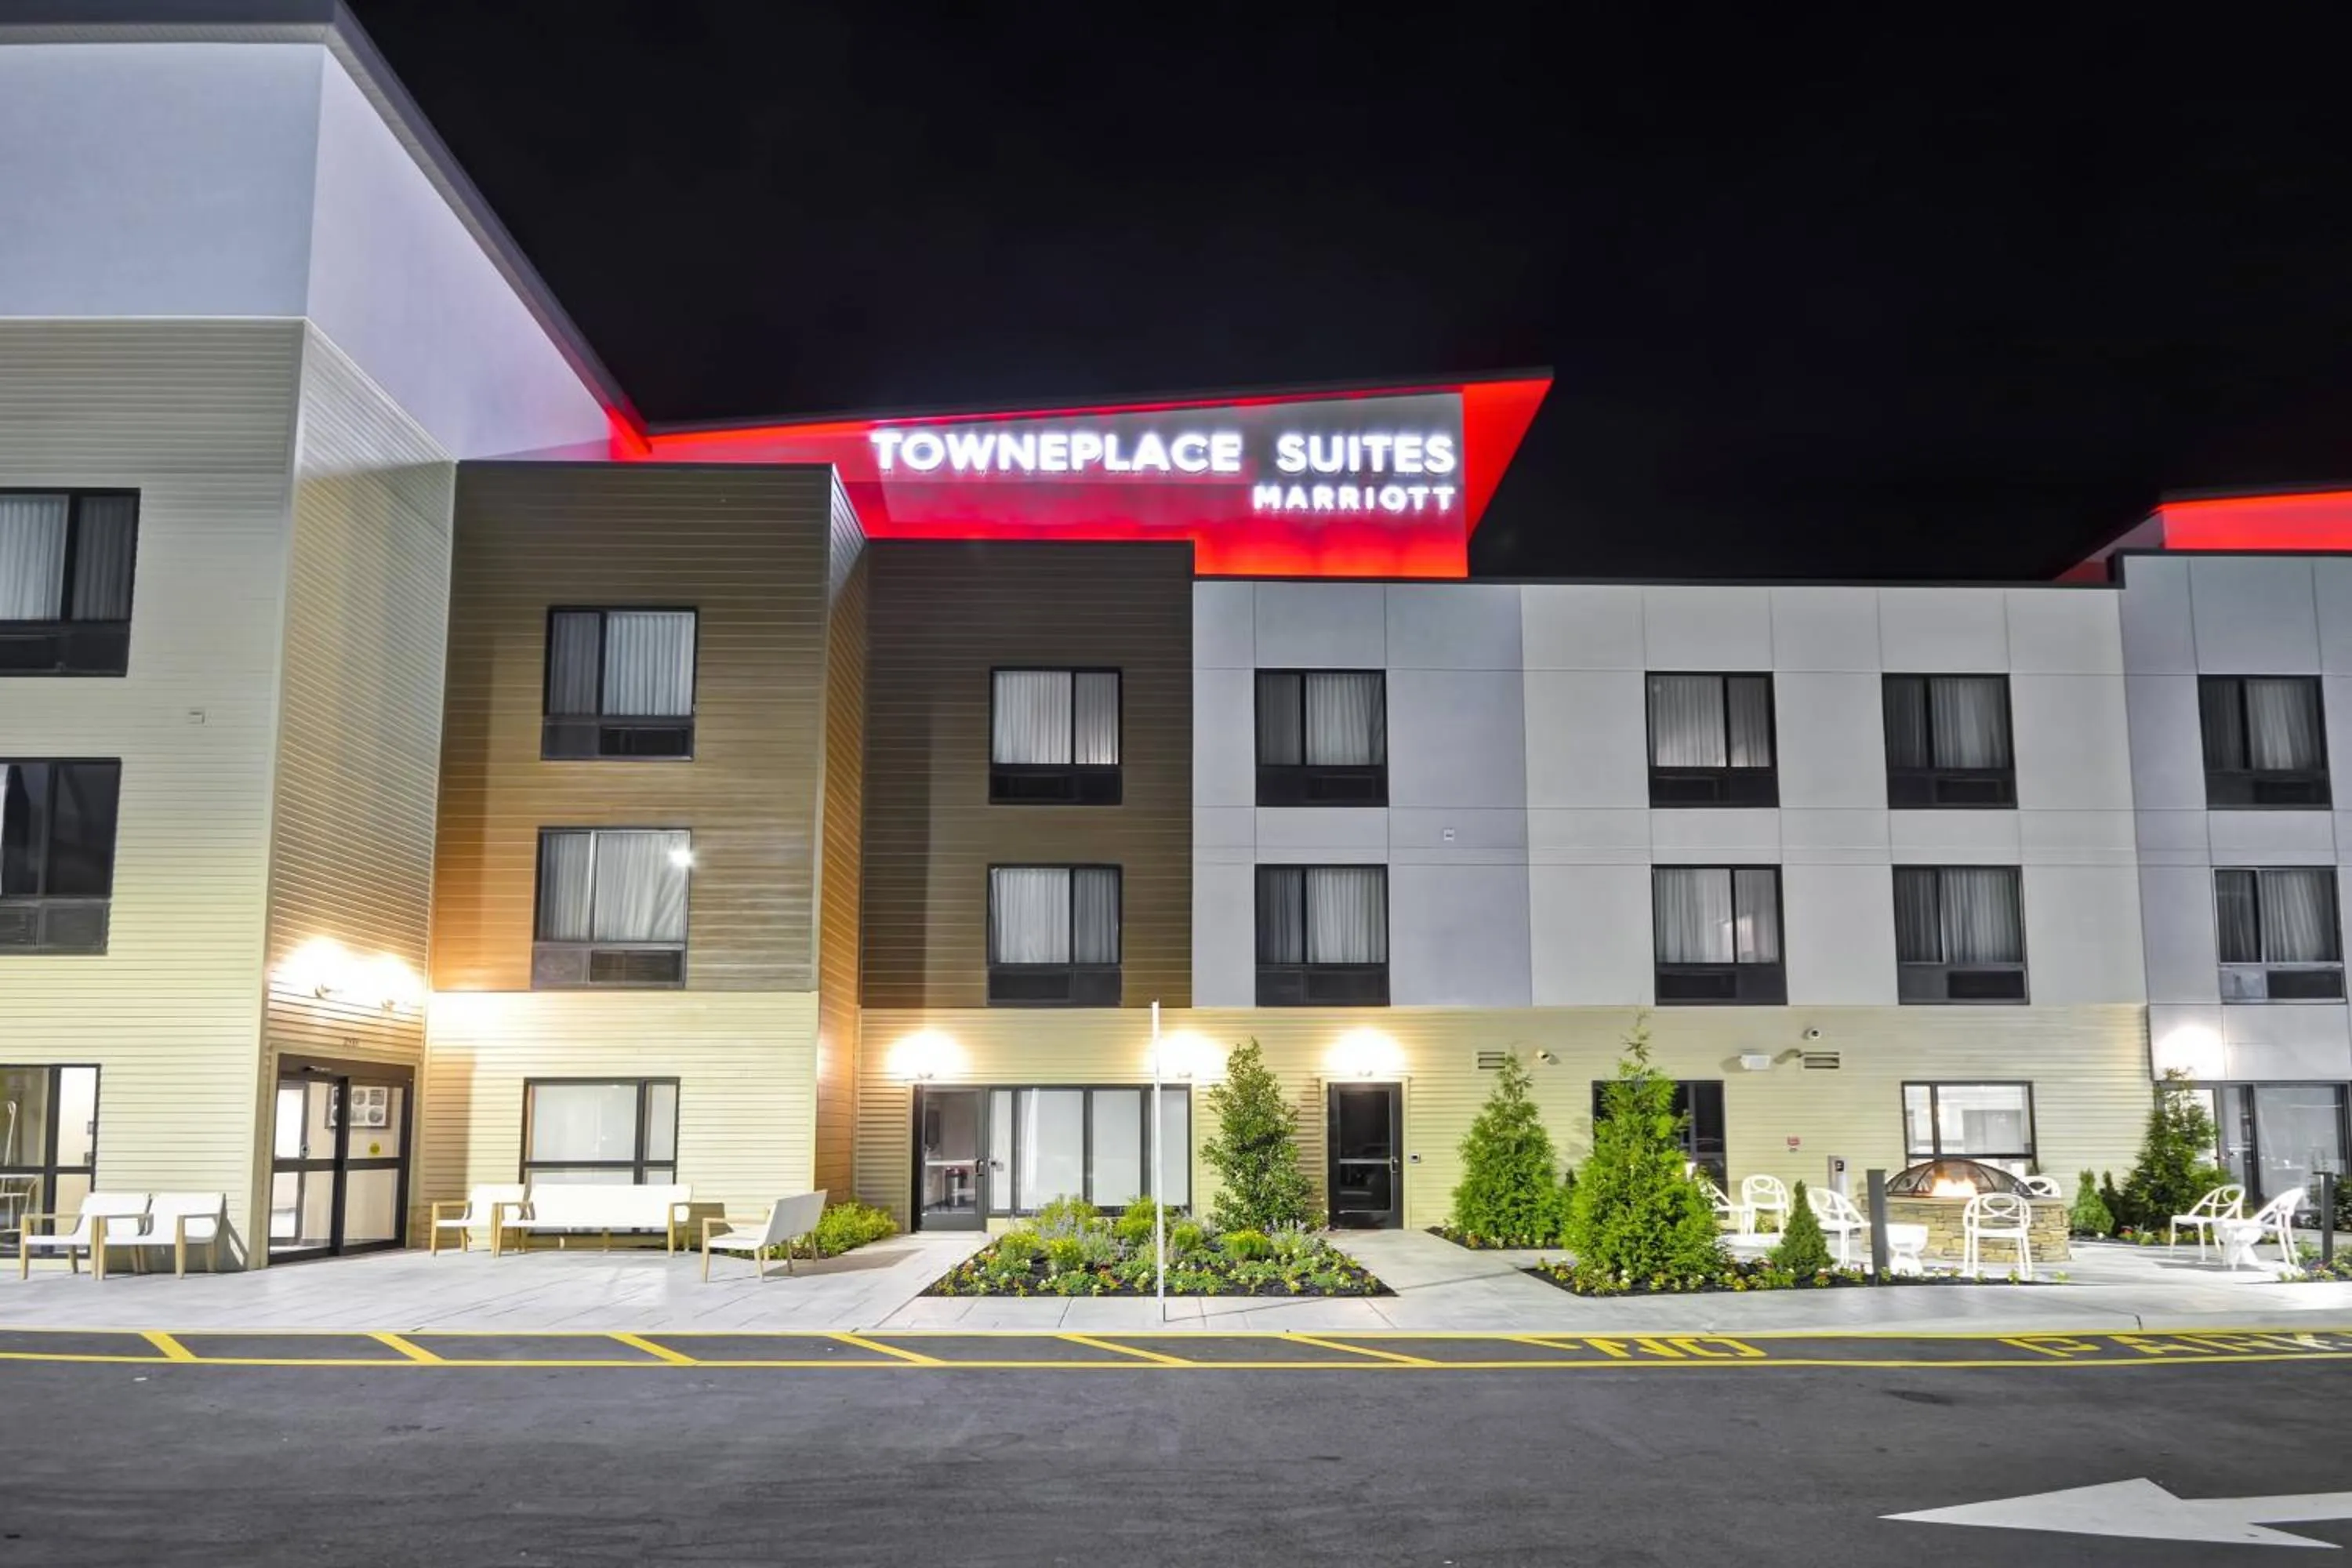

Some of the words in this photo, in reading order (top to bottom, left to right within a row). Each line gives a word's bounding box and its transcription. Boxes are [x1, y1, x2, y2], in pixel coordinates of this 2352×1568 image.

[869, 432, 1242, 473] TOWNEPLACE
[1277, 432, 1456, 474] SUITES
[1253, 485, 1456, 512] MARRIOTT
[1582, 1338, 1768, 1358] NO
[1997, 1332, 2352, 1357] PARK
